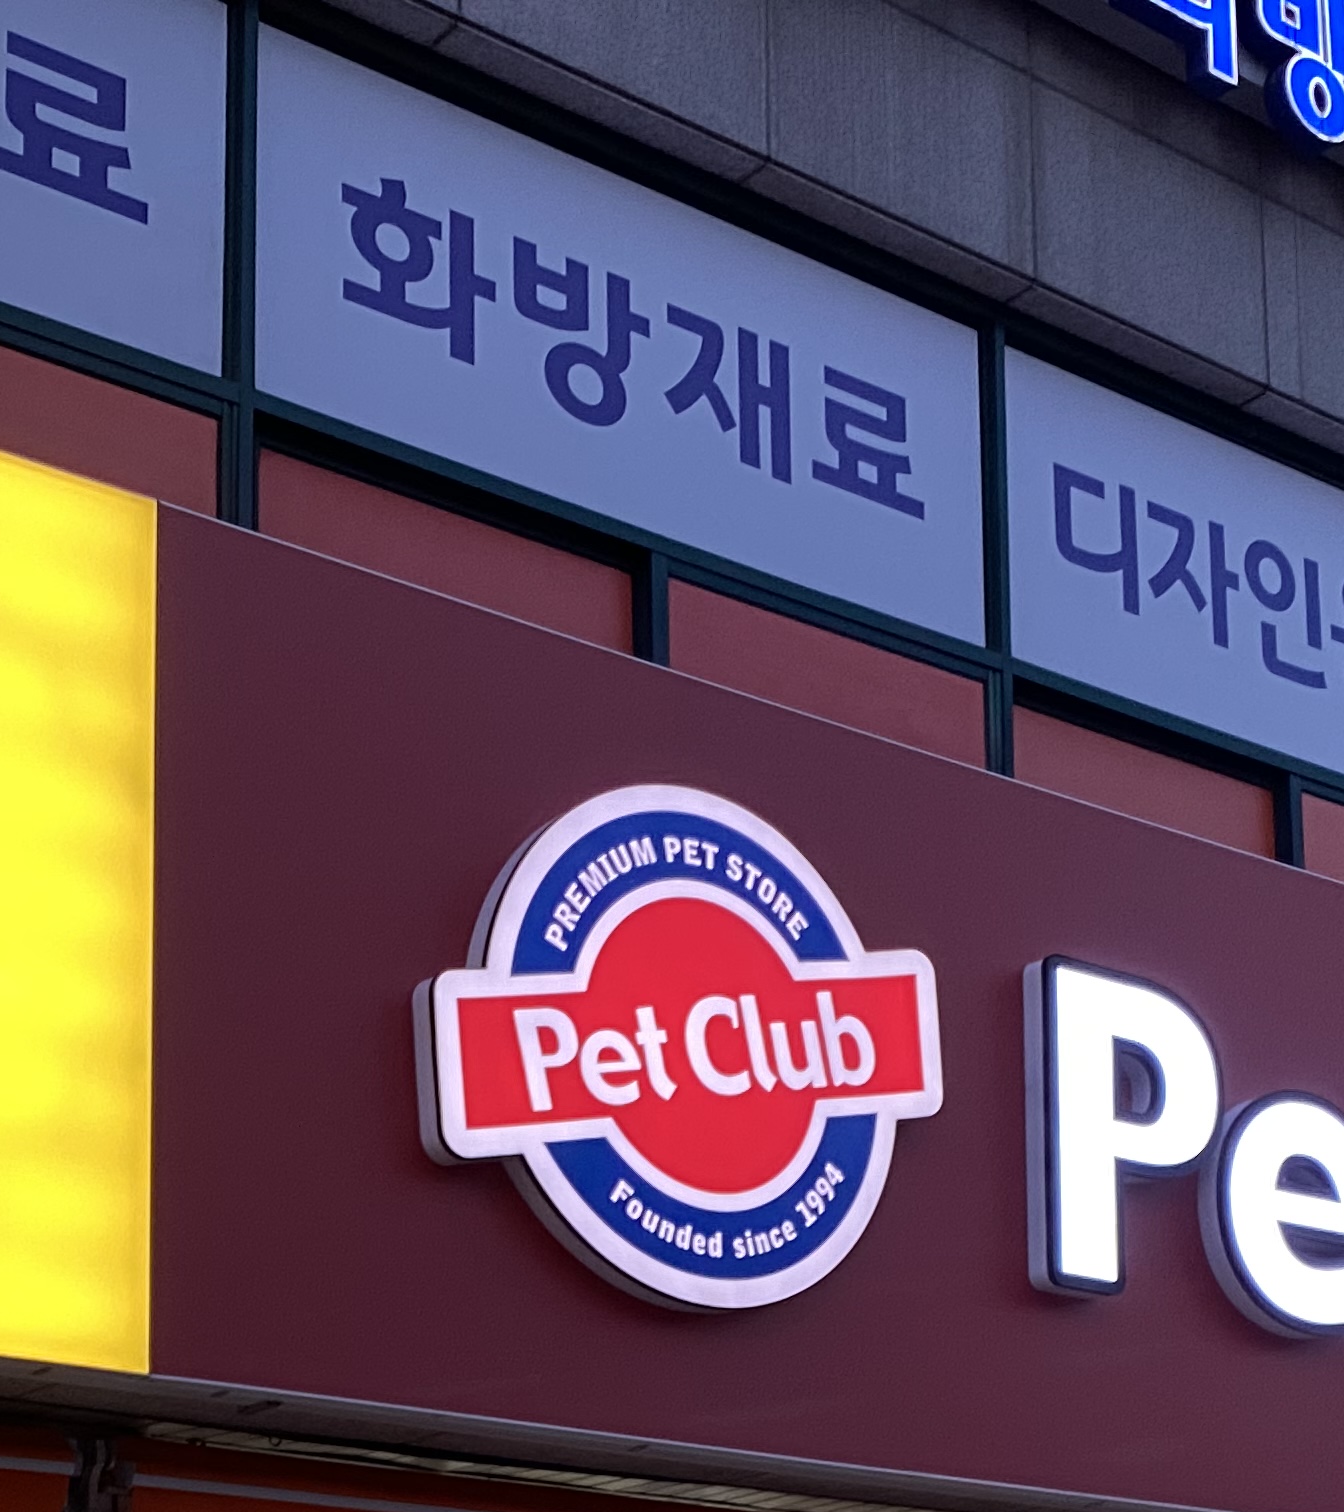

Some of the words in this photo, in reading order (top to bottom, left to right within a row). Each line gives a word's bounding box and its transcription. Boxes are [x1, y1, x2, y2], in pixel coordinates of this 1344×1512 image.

[341, 177, 925, 521] 화방재료
[545, 836, 657, 952] PREMIUM
[662, 836, 719, 871] PET
[725, 852, 810, 942] STORE
[513, 1005, 677, 1112] Pet
[684, 991, 876, 1097] Club
[609, 1178, 724, 1258] Founded
[732, 1220, 797, 1260] since
[795, 1161, 845, 1228] 1994
